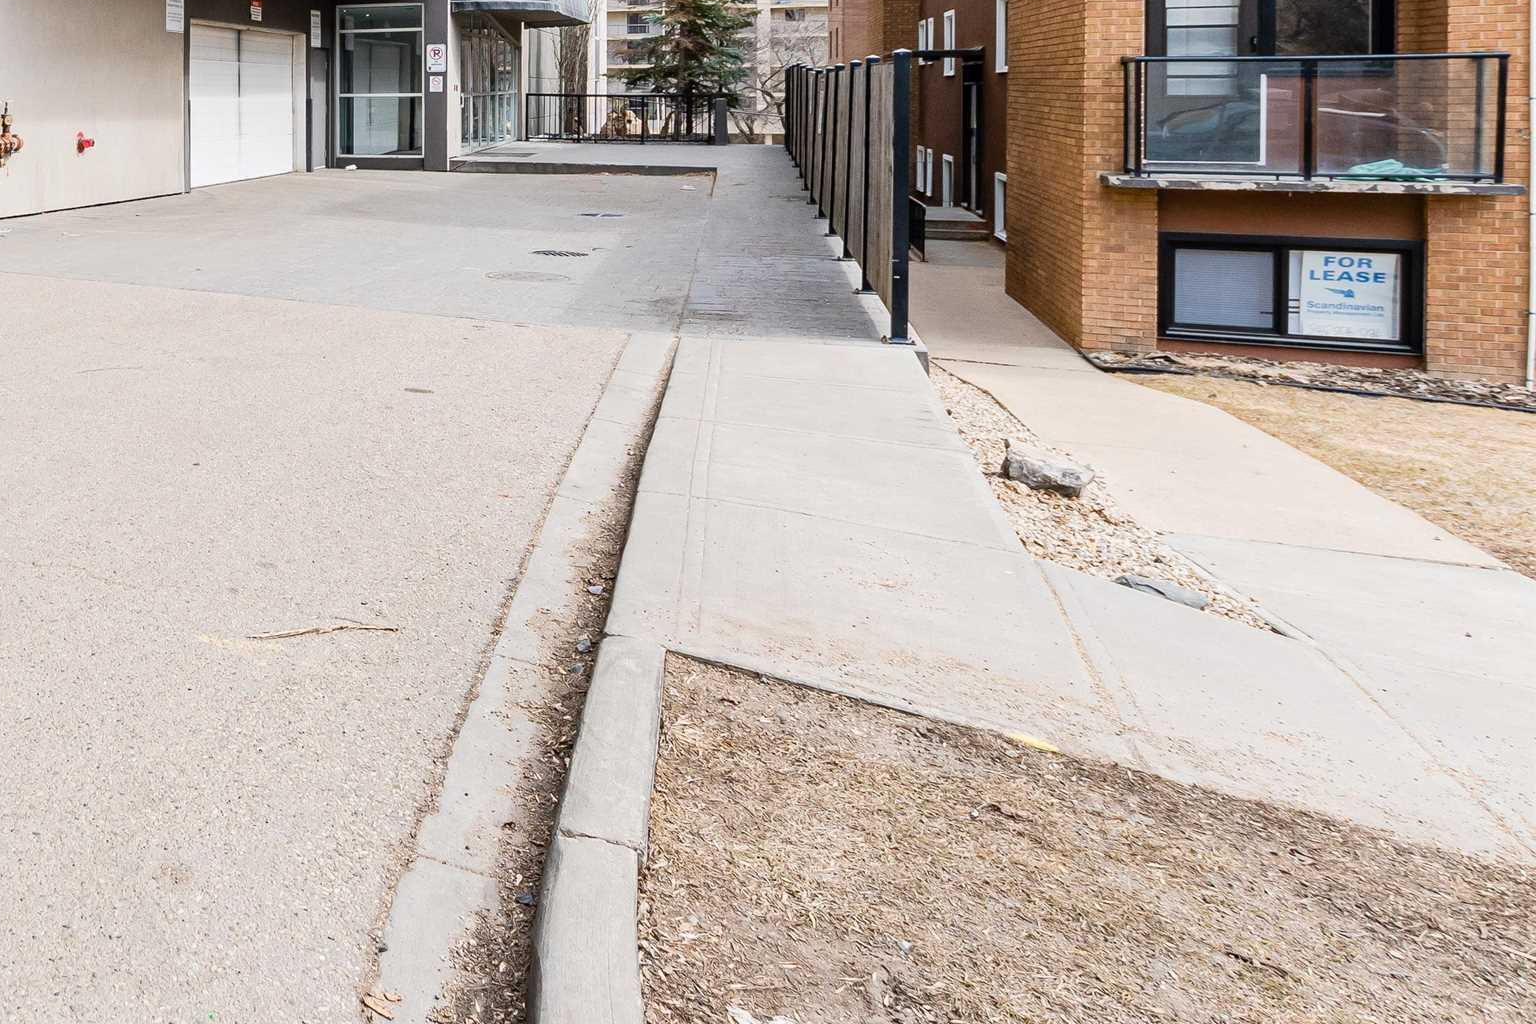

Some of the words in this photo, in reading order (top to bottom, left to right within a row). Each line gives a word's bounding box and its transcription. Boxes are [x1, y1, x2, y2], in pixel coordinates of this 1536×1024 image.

[1323, 255, 1373, 269] FOR
[1309, 269, 1386, 284] LEASE
[1306, 300, 1385, 312] Scandinavian
